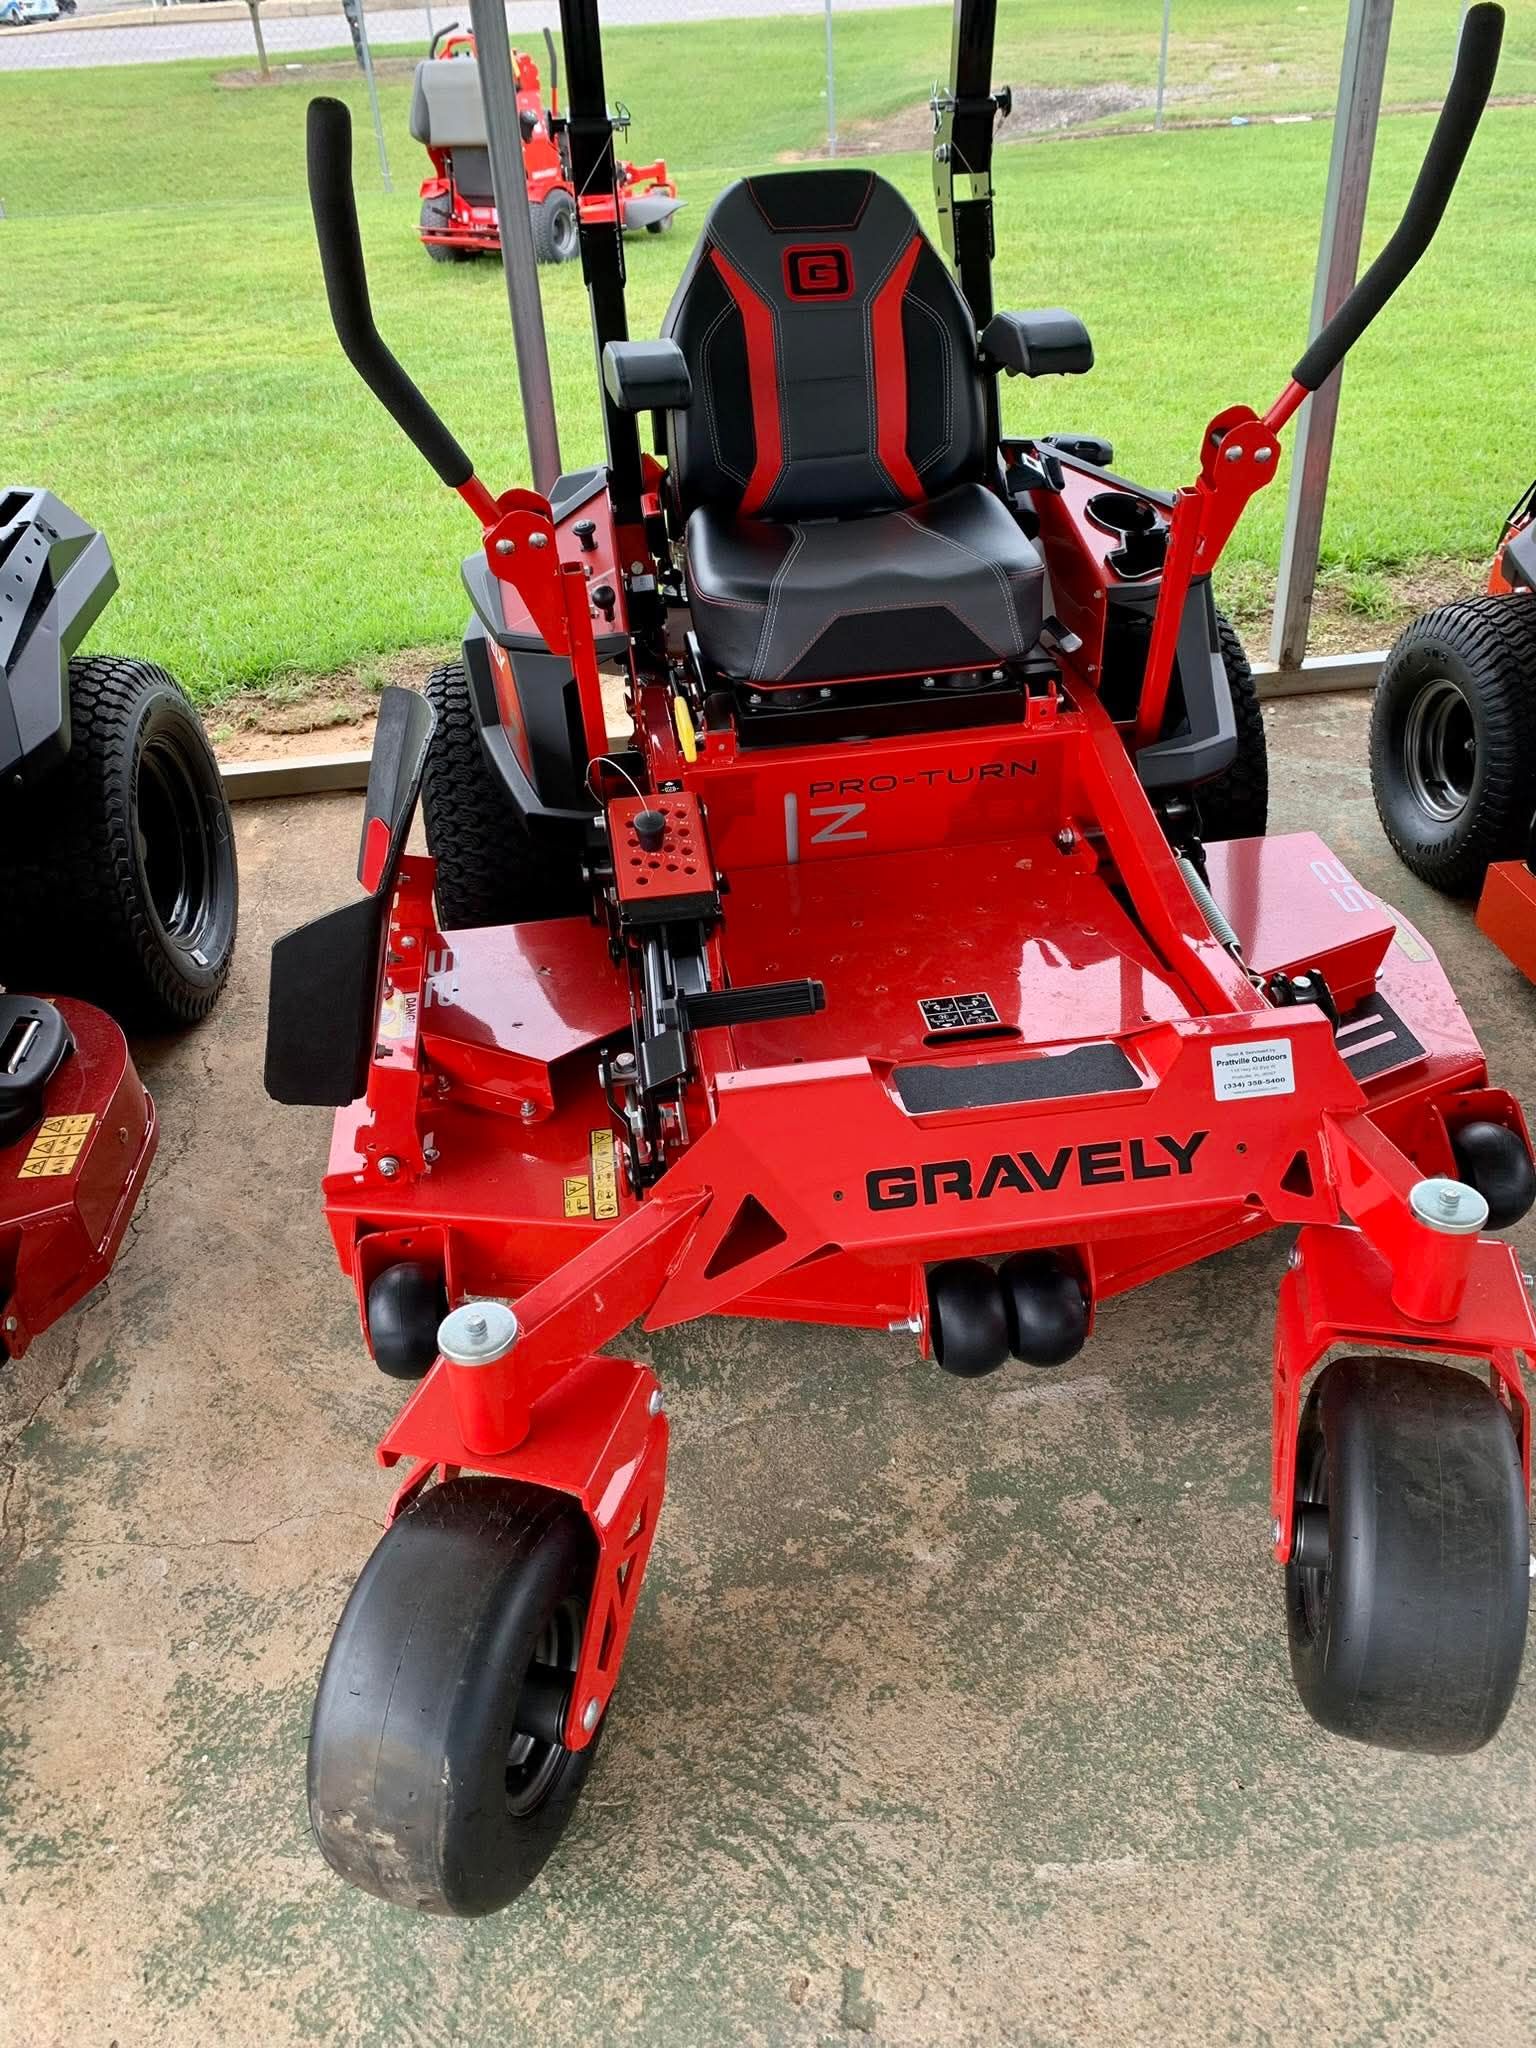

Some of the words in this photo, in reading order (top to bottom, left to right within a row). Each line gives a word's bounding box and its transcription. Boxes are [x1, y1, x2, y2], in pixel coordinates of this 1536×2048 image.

[809, 759, 1038, 799] PRO-TURN
[810, 803, 868, 844] Z
[1216, 1057, 1250, 1067] Prattville
[1251, 1054, 1287, 1063] Outdoors
[1223, 1081, 1245, 1090] (334)
[866, 1130, 1210, 1212] GRAVELY
